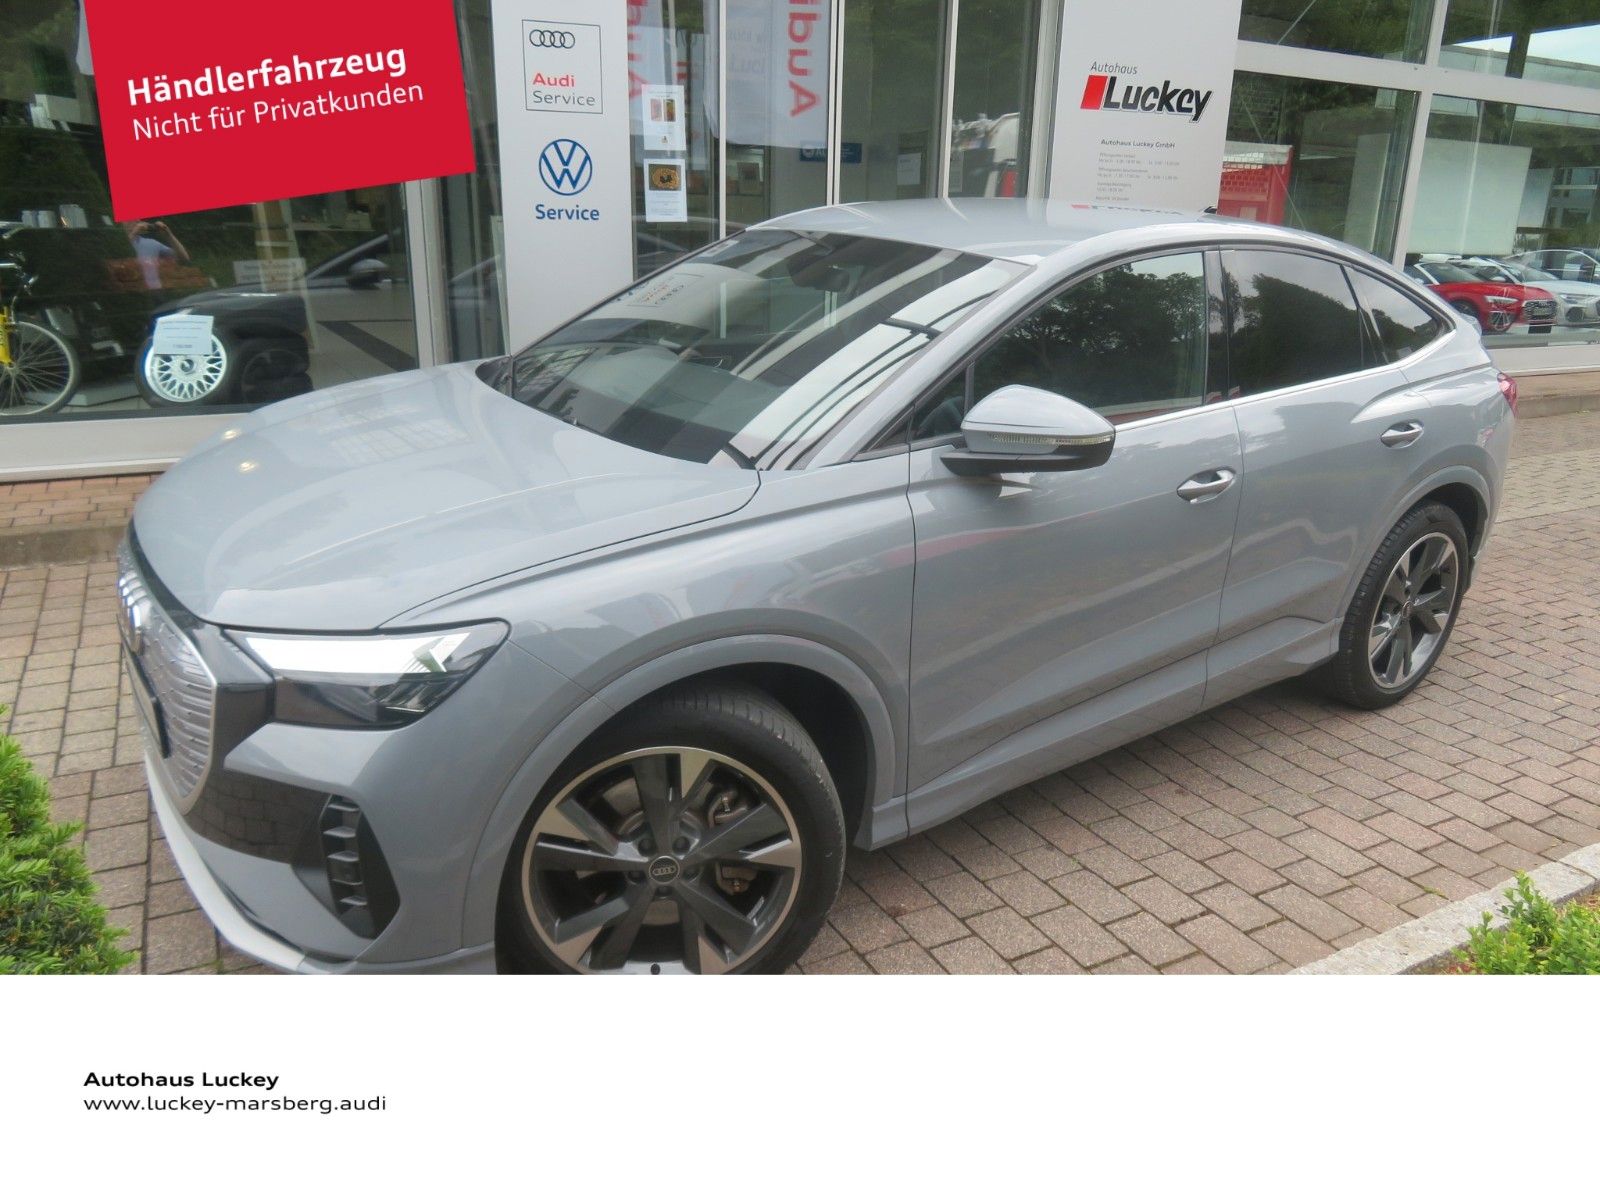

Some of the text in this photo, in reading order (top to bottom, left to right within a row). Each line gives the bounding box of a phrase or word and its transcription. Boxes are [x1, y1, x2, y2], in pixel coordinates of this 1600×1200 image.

[1090, 61, 1138, 75] Autohaus
[532, 72, 576, 87] Audi
[532, 90, 596, 106] Service
[1102, 75, 1213, 122] Luckey
[1101, 139, 1131, 147] Autohaus
[1133, 140, 1154, 148] Luckey
[535, 204, 600, 221] Service
